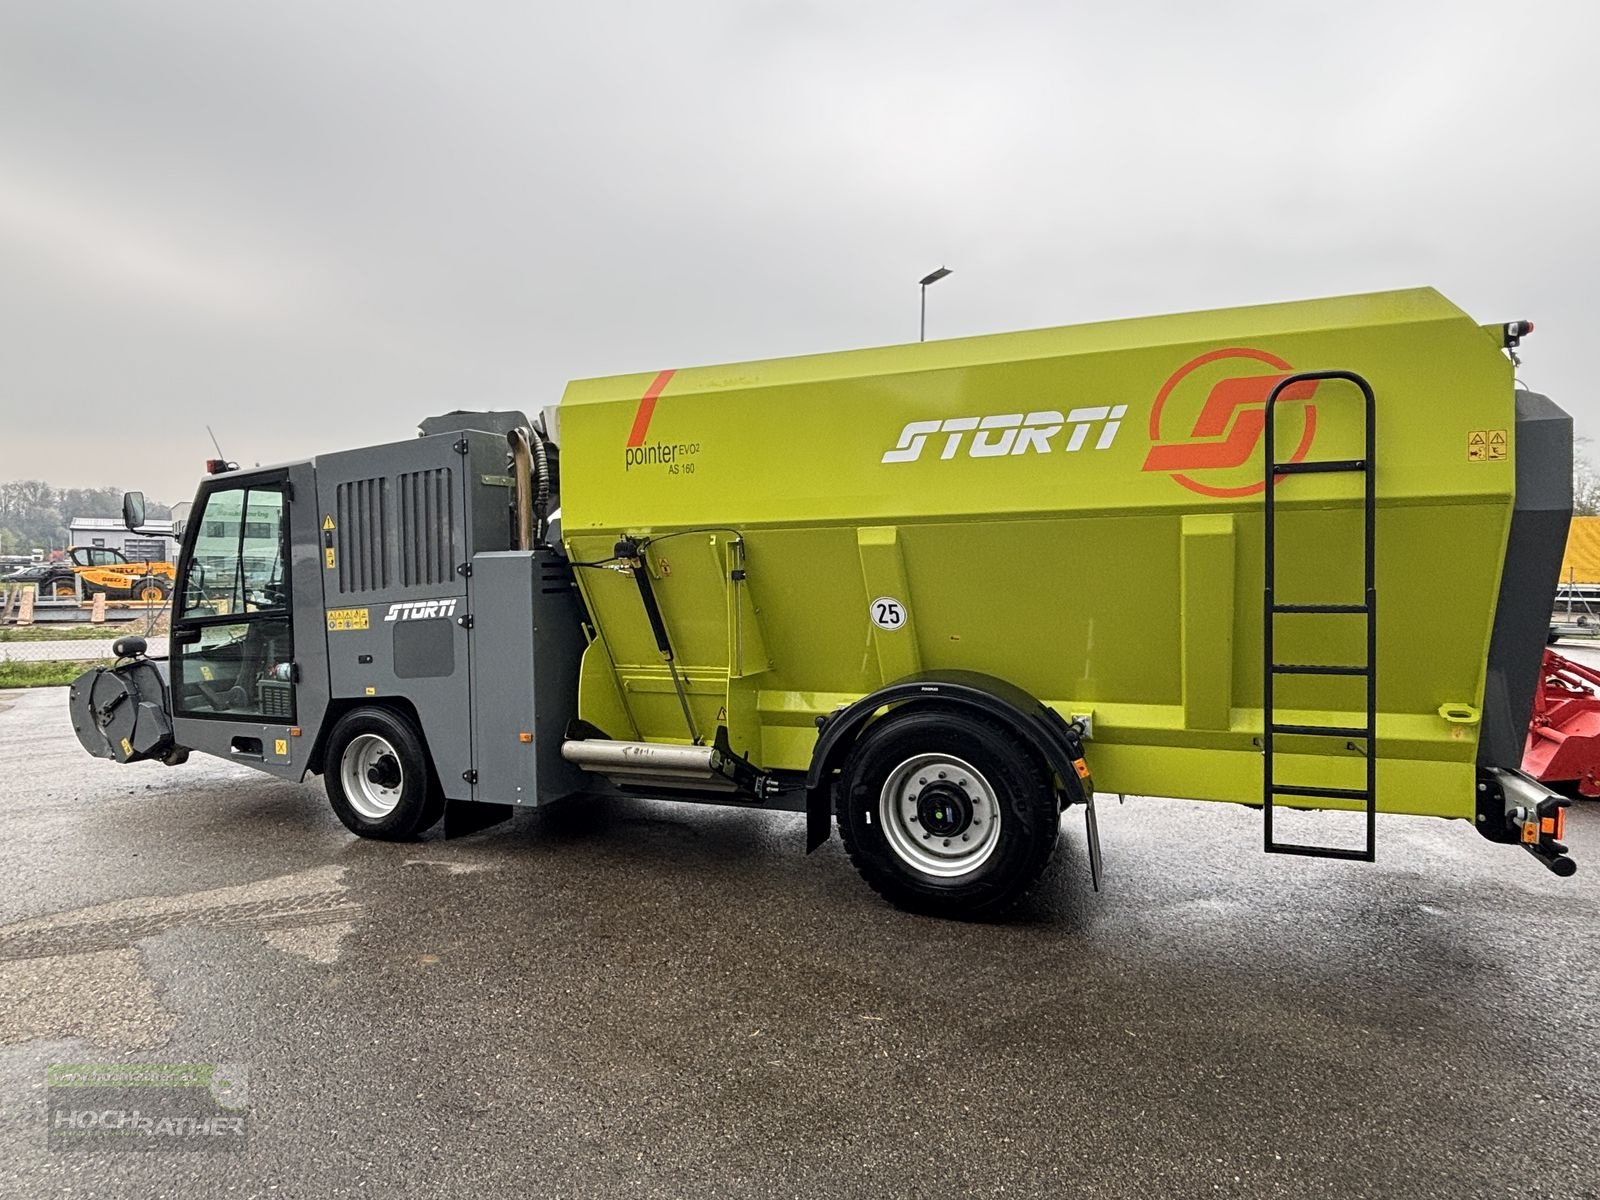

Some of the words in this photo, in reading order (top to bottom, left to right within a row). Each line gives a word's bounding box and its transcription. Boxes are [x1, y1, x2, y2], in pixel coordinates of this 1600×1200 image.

[881, 404, 1128, 463] STORTI
[626, 441, 677, 472] pointer
[668, 464, 680, 475] AS
[682, 463, 695, 474] 160
[384, 599, 457, 621] STORTI
[877, 603, 900, 624] 25
